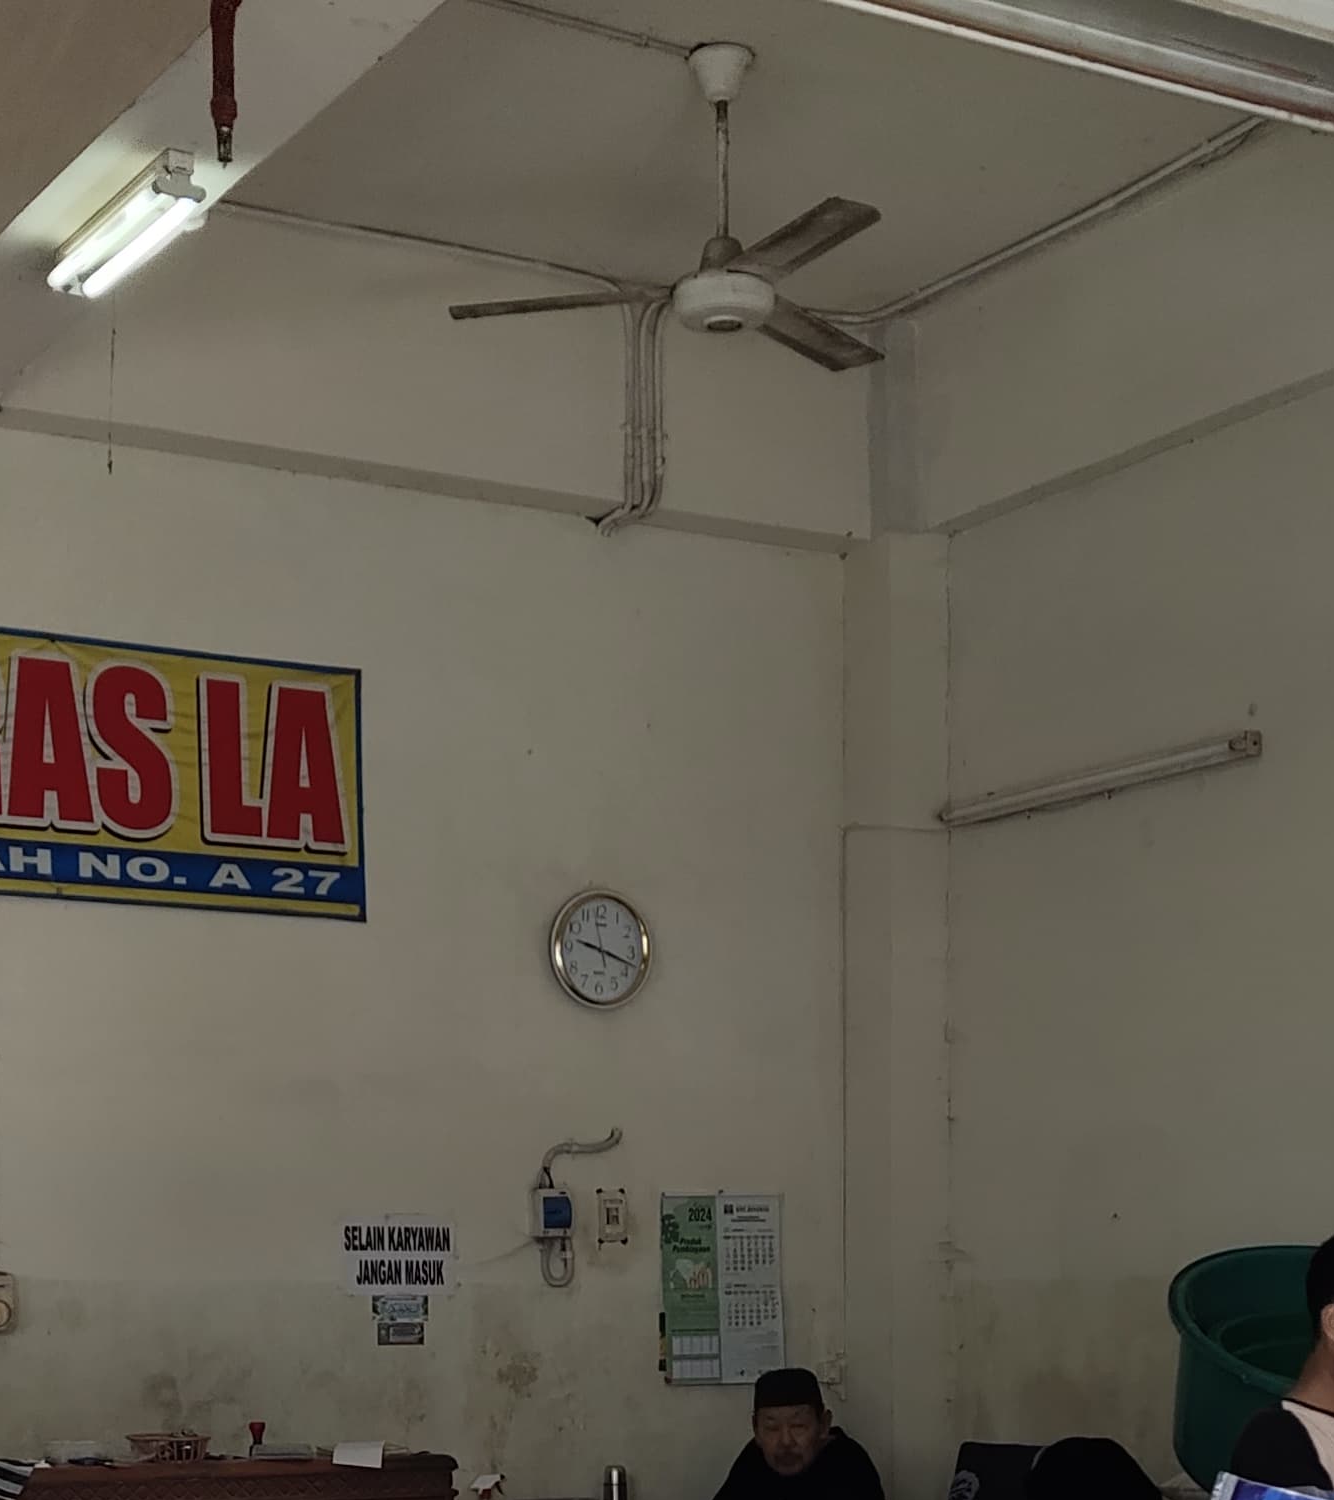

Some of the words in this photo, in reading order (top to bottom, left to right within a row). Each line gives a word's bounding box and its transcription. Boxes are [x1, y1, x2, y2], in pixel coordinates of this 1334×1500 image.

[204, 676, 349, 849] LA
[78, 849, 187, 887] NO.
[209, 860, 252, 890] A
[271, 865, 342, 898] 27
[688, 1207, 712, 1222] 2024
[344, 1225, 385, 1251] SELAIN
[388, 1226, 451, 1252] KARYAWAN
[356, 1259, 402, 1285] JANGAN
[405, 1259, 445, 1285] MASUK
